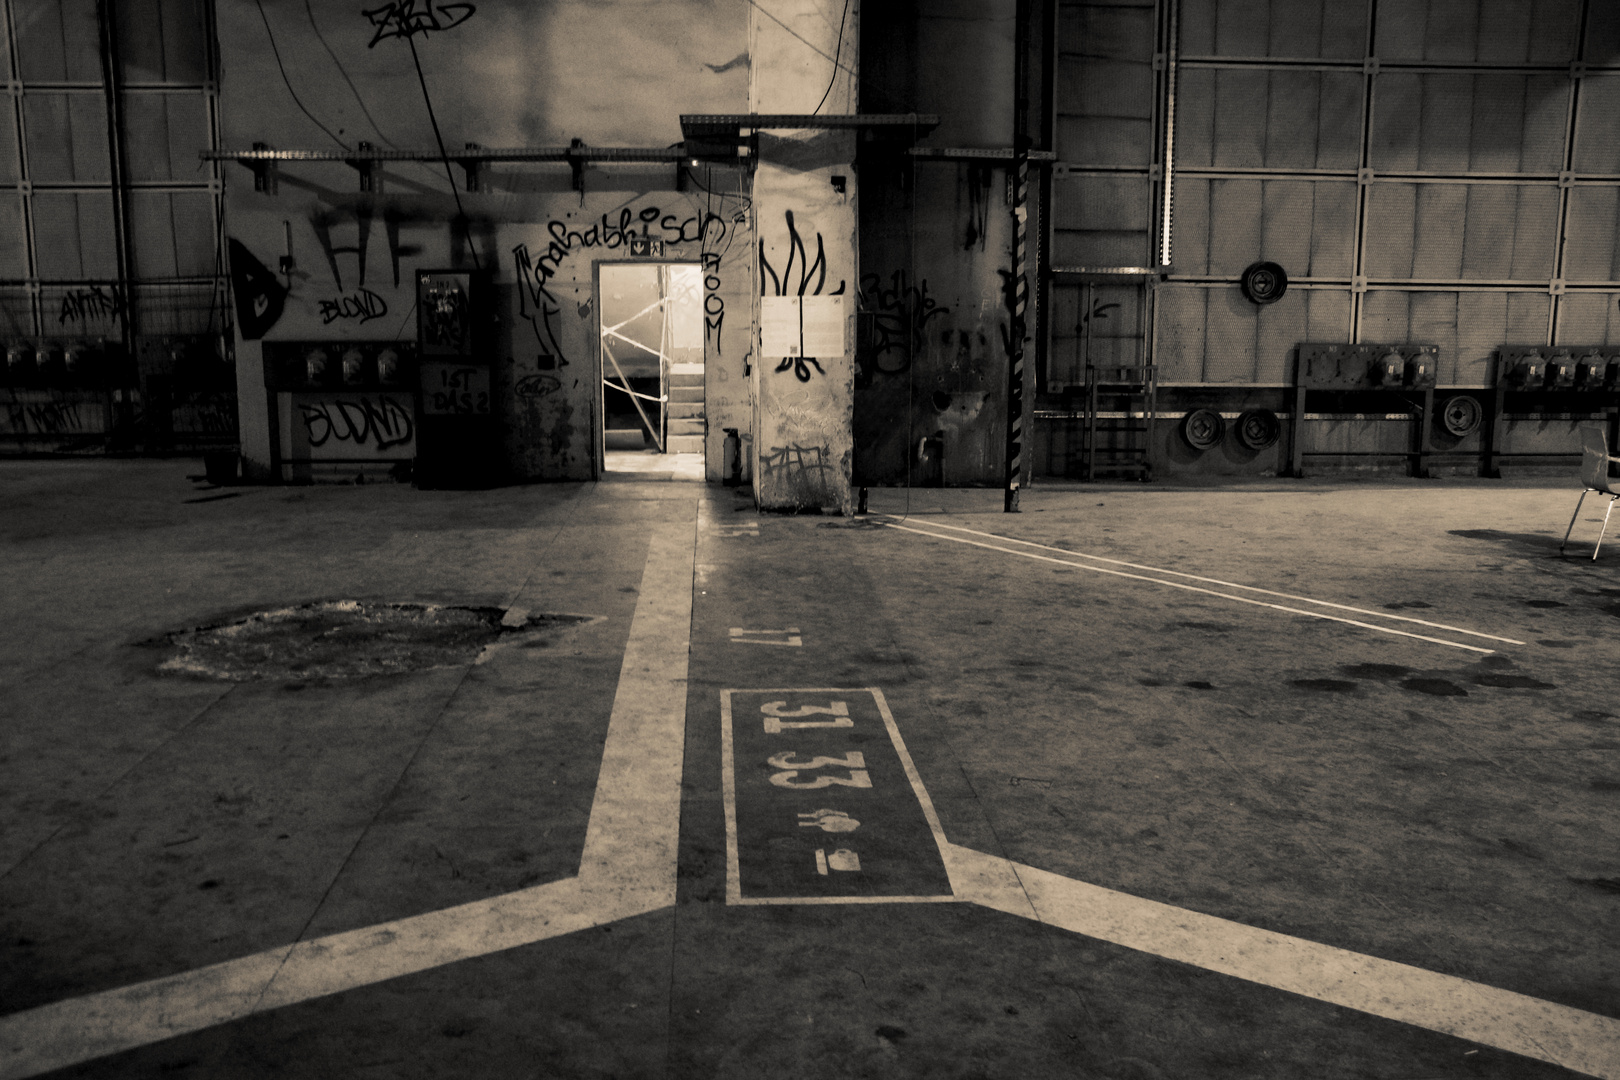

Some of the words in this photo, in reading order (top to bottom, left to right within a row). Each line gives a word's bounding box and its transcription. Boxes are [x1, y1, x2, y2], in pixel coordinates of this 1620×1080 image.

[728, 626, 803, 647] 17
[760, 700, 855, 734] 31
[766, 750, 874, 789] 33
